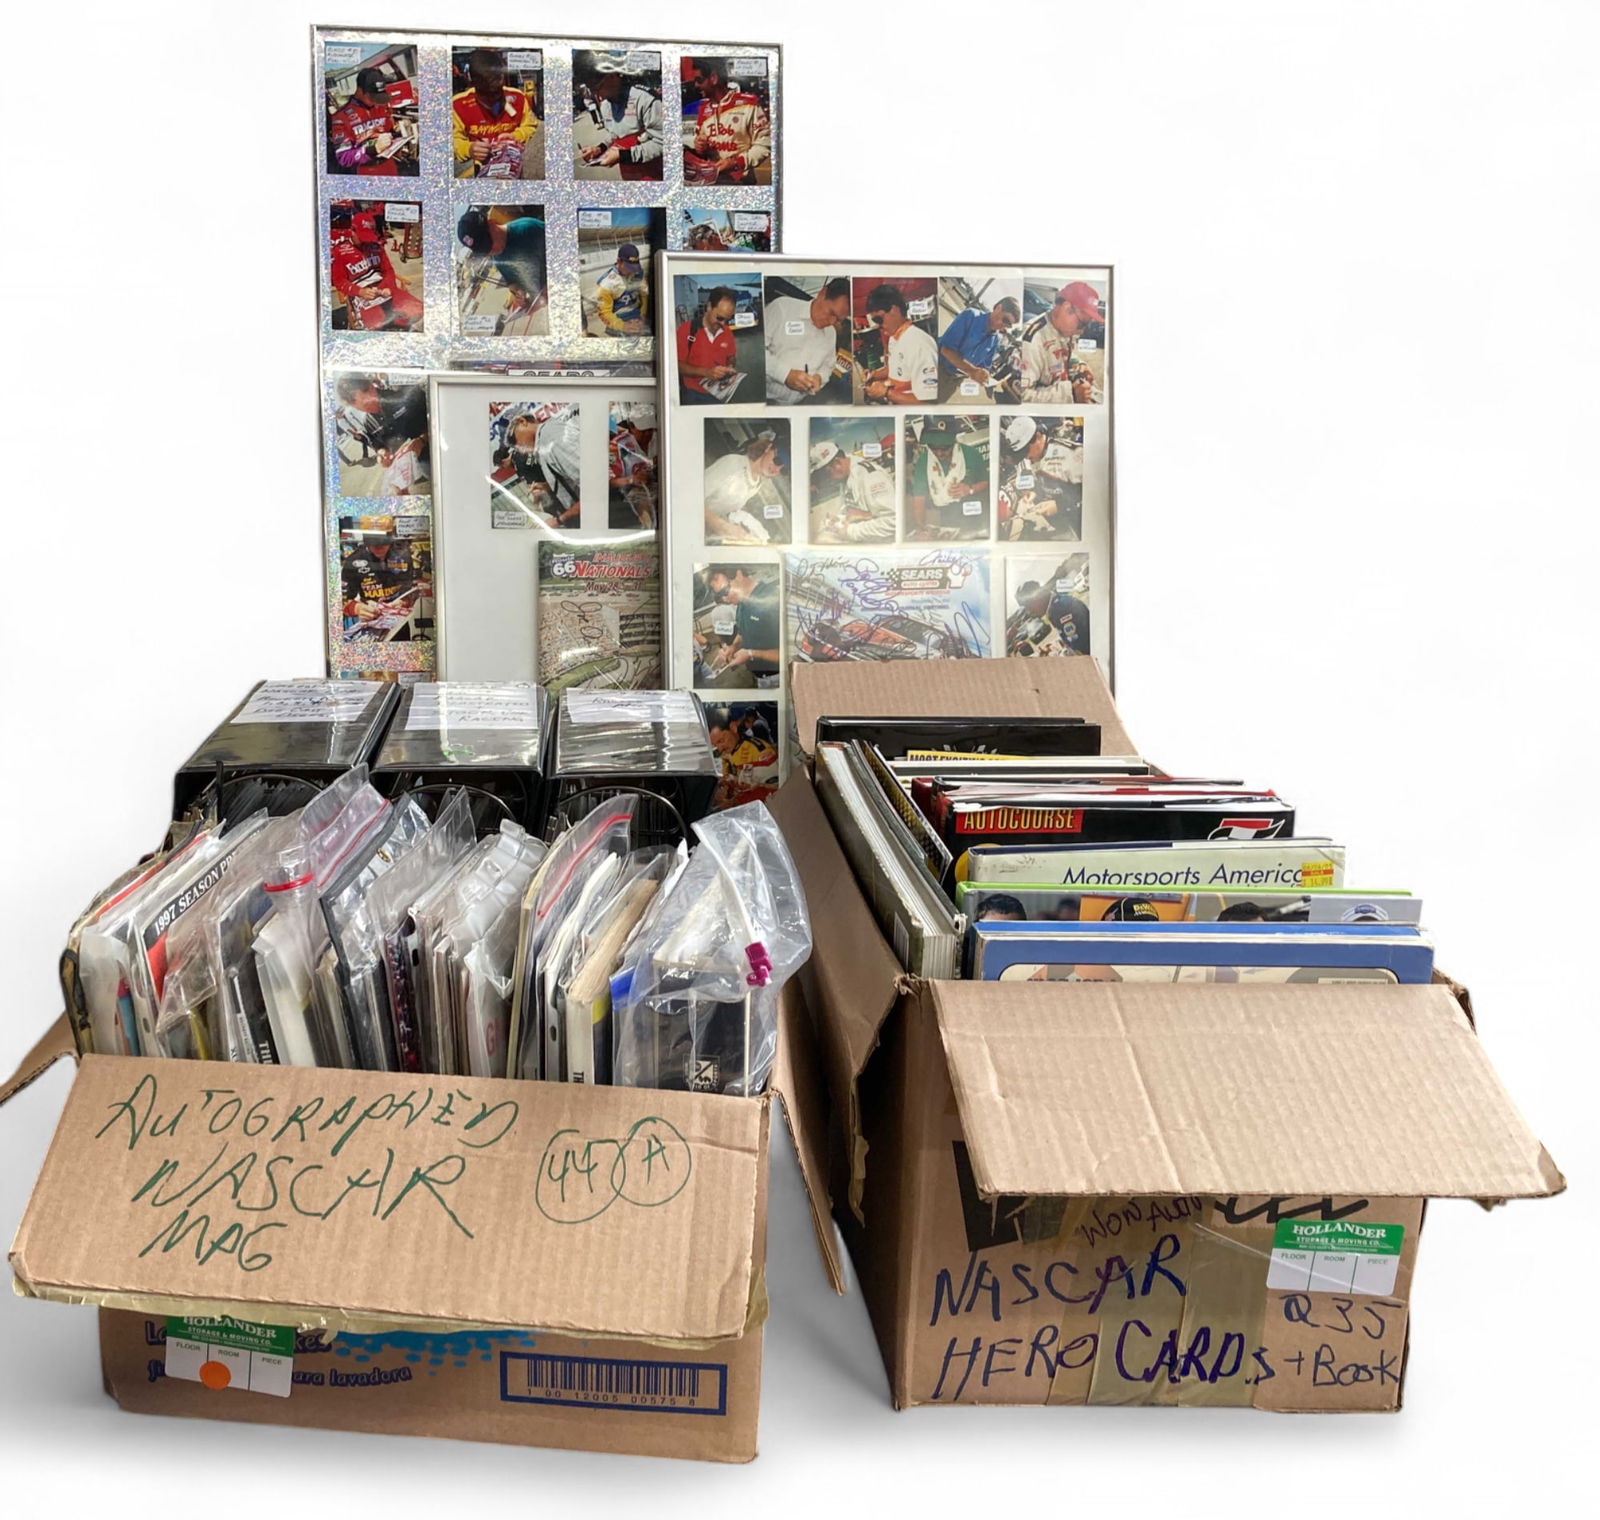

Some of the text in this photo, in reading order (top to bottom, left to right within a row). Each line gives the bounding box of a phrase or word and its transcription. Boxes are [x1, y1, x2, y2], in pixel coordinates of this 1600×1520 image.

[552, 560, 577, 577] 66
[901, 569, 944, 580] SEARS
[964, 807, 1075, 830] AUTOCOURSE
[1061, 866, 1201, 886] Motorsports
[153, 903, 177, 937] 1997
[178, 869, 220, 913] SEASON
[131, 1142, 475, 1239] NASCAR
[1292, 1222, 1386, 1239] HOLLANDER
[138, 1209, 289, 1272] MAG
[1280, 1252, 1307, 1260] FLOOR
[929, 1234, 1187, 1327] NASCAR
[187, 1326, 221, 1338] STORAGE
[229, 1333, 259, 1344] MOVING
[176, 1341, 201, 1351] FLOOR
[218, 1349, 240, 1358] ROOM
[261, 1357, 283, 1366] PIECE
[931, 1325, 1099, 1401] HERO
[329, 1365, 412, 1387] lavadora
[575, 1391, 619, 1403] 12005
